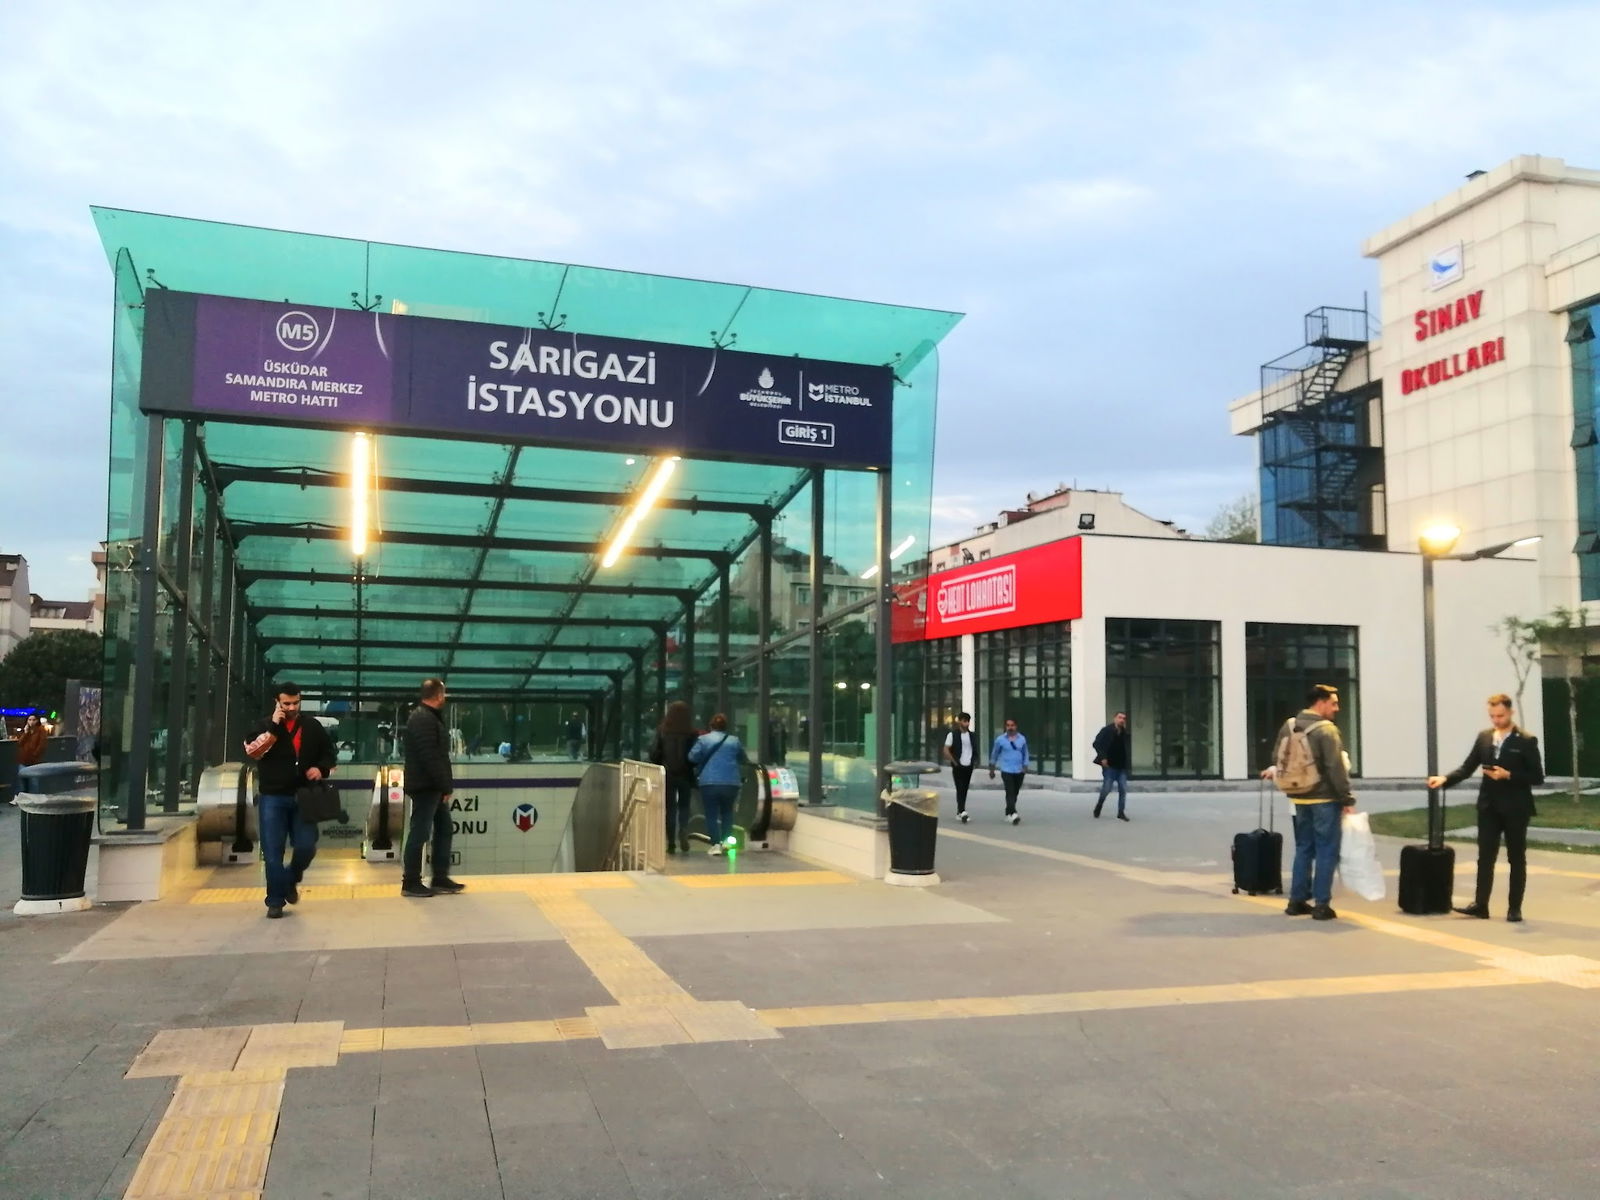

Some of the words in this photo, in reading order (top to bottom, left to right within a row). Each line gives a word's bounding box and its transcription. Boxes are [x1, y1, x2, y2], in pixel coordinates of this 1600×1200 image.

[1414, 289, 1484, 341] SINAV
[281, 322, 314, 341] M5
[263, 359, 328, 377] ÜSKÜDAR
[489, 340, 656, 385] SARIGAZİ
[1401, 336, 1505, 395] OKULLARI
[225, 373, 307, 390] SAMANDIRA
[311, 380, 363, 395] MERKEZ
[824, 383, 860, 396] METRO
[250, 390, 297, 404] METRO
[301, 394, 338, 408] HATTI
[467, 375, 674, 428] İSTASYONU
[824, 392, 873, 407] İSTANBUL
[785, 425, 818, 442] GİRİŞ
[821, 429, 827, 440] 1
[966, 572, 1012, 611] LOKANTASI
